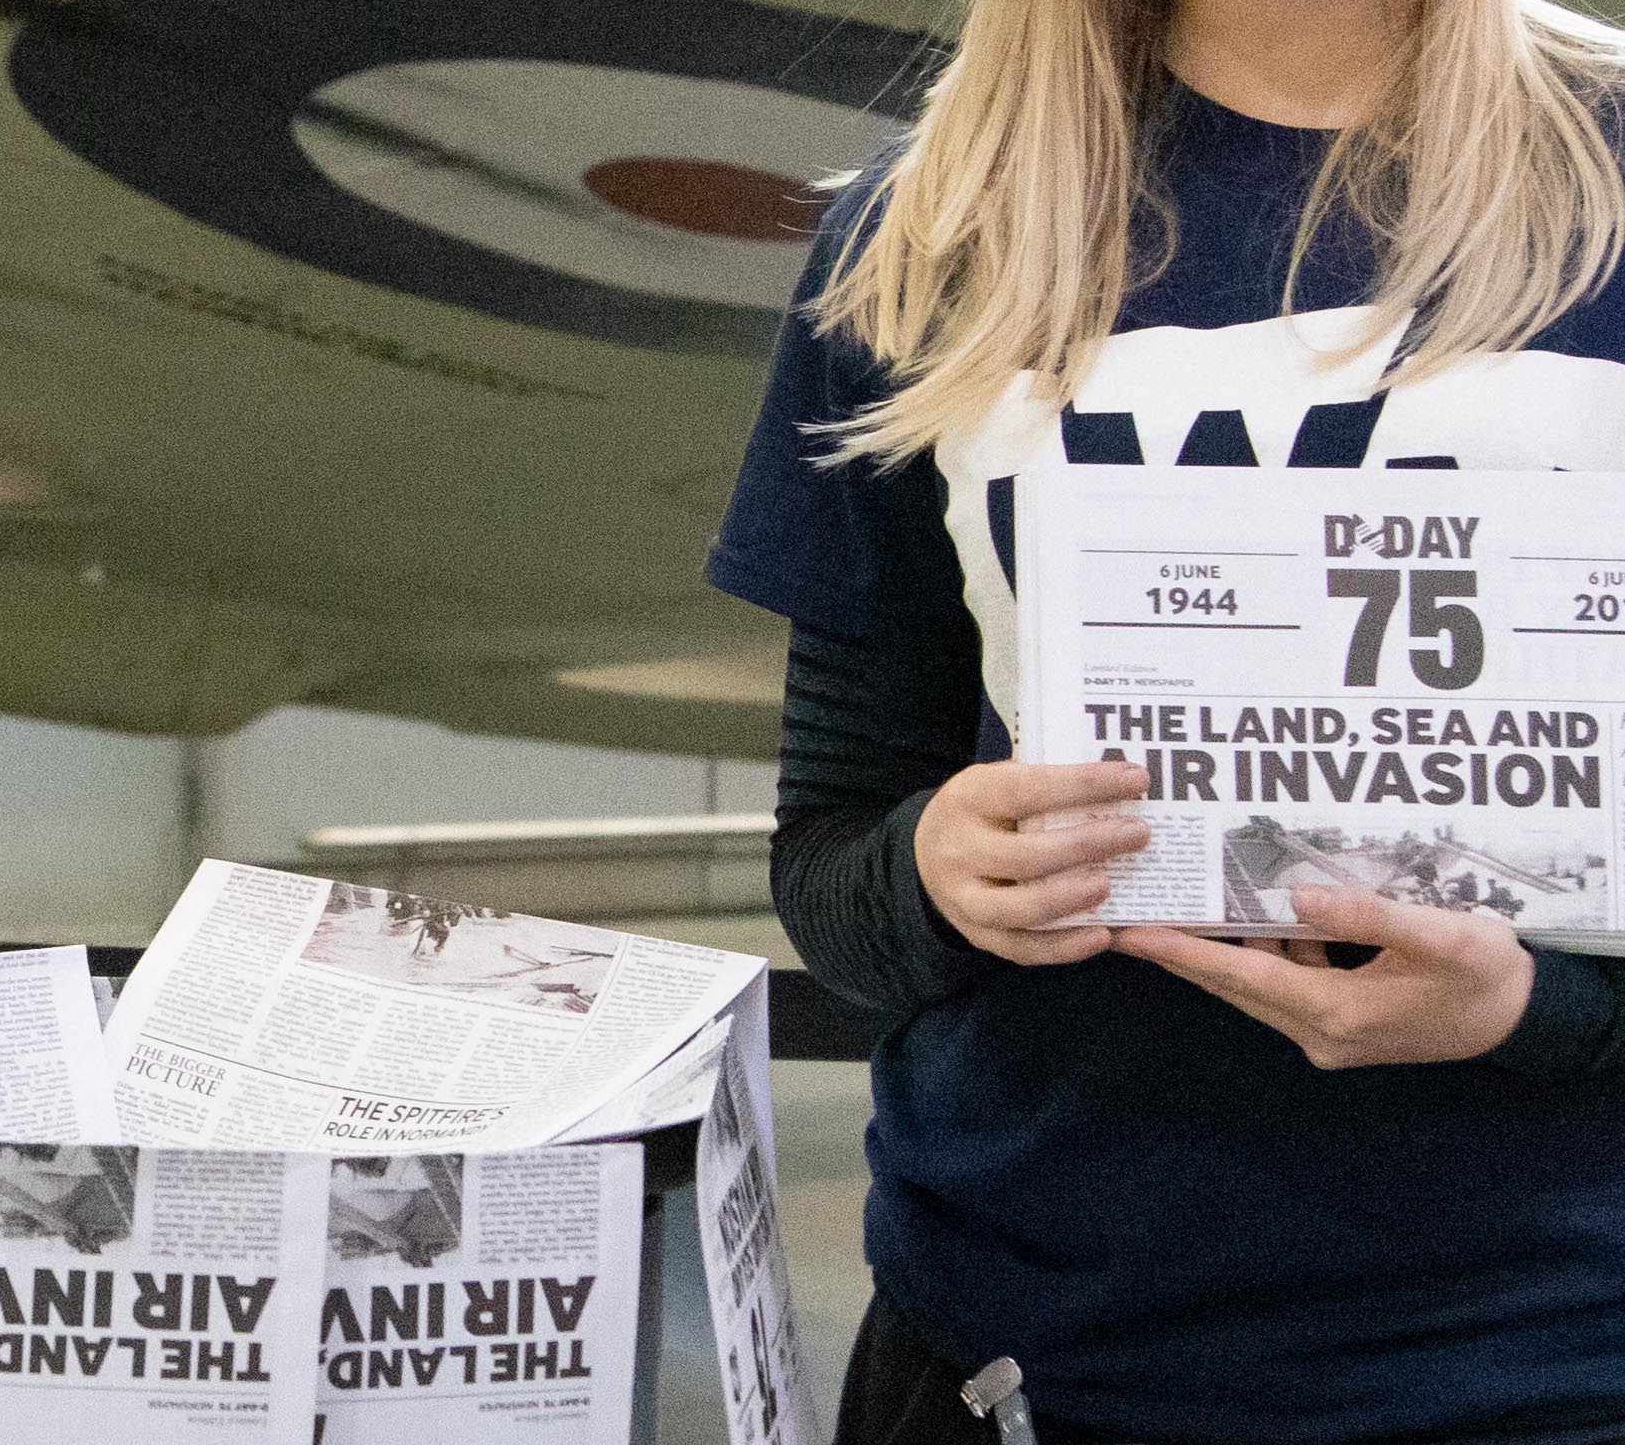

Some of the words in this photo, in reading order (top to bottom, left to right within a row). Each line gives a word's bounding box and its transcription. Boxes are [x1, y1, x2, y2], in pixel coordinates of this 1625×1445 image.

[1159, 565, 1170, 579] 6
[1170, 565, 1221, 581] JUNE
[1588, 571, 1599, 586] 6
[1145, 586, 1238, 617] 1944
[1326, 568, 1486, 692] 75
[1084, 704, 1187, 742] THE
[1200, 706, 1360, 749] LAND,
[1371, 708, 1489, 748] SEA
[1489, 711, 1600, 749] AND
[1099, 748, 1220, 803] IR
[1235, 751, 1602, 809] INVASION
[125, 1055, 223, 1097] PICTURE
[133, 1042, 166, 1064] THE
[167, 1051, 227, 1082] BIGGER
[323, 1121, 374, 1140] ROLE
[372, 1127, 394, 1141] IN
[337, 1096, 388, 1121] THE
[387, 1104, 511, 1125] SPITFIRE'S
[132, 1272, 277, 1333] AIR
[462, 1276, 597, 1336] AIR
[161, 1339, 271, 1382] THE
[318, 1345, 477, 1389] LAND,
[490, 1340, 591, 1382] THE
